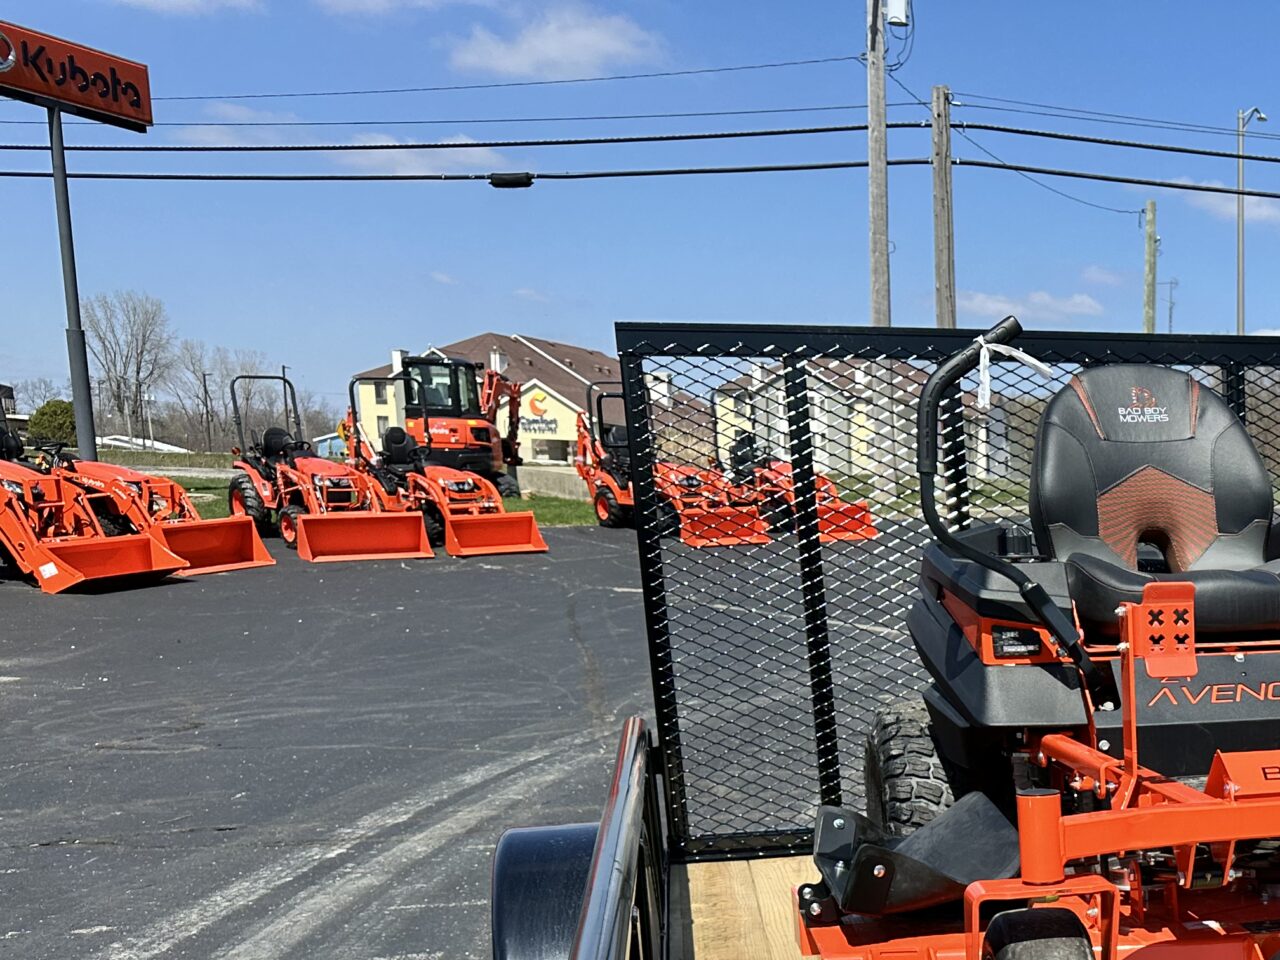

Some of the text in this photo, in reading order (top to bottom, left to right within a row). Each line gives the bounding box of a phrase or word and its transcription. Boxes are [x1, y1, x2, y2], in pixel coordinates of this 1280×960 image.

[20, 40, 141, 108] Kubota
[1118, 406, 1167, 415] BAD BOY
[1120, 414, 1169, 423] MOWERS
